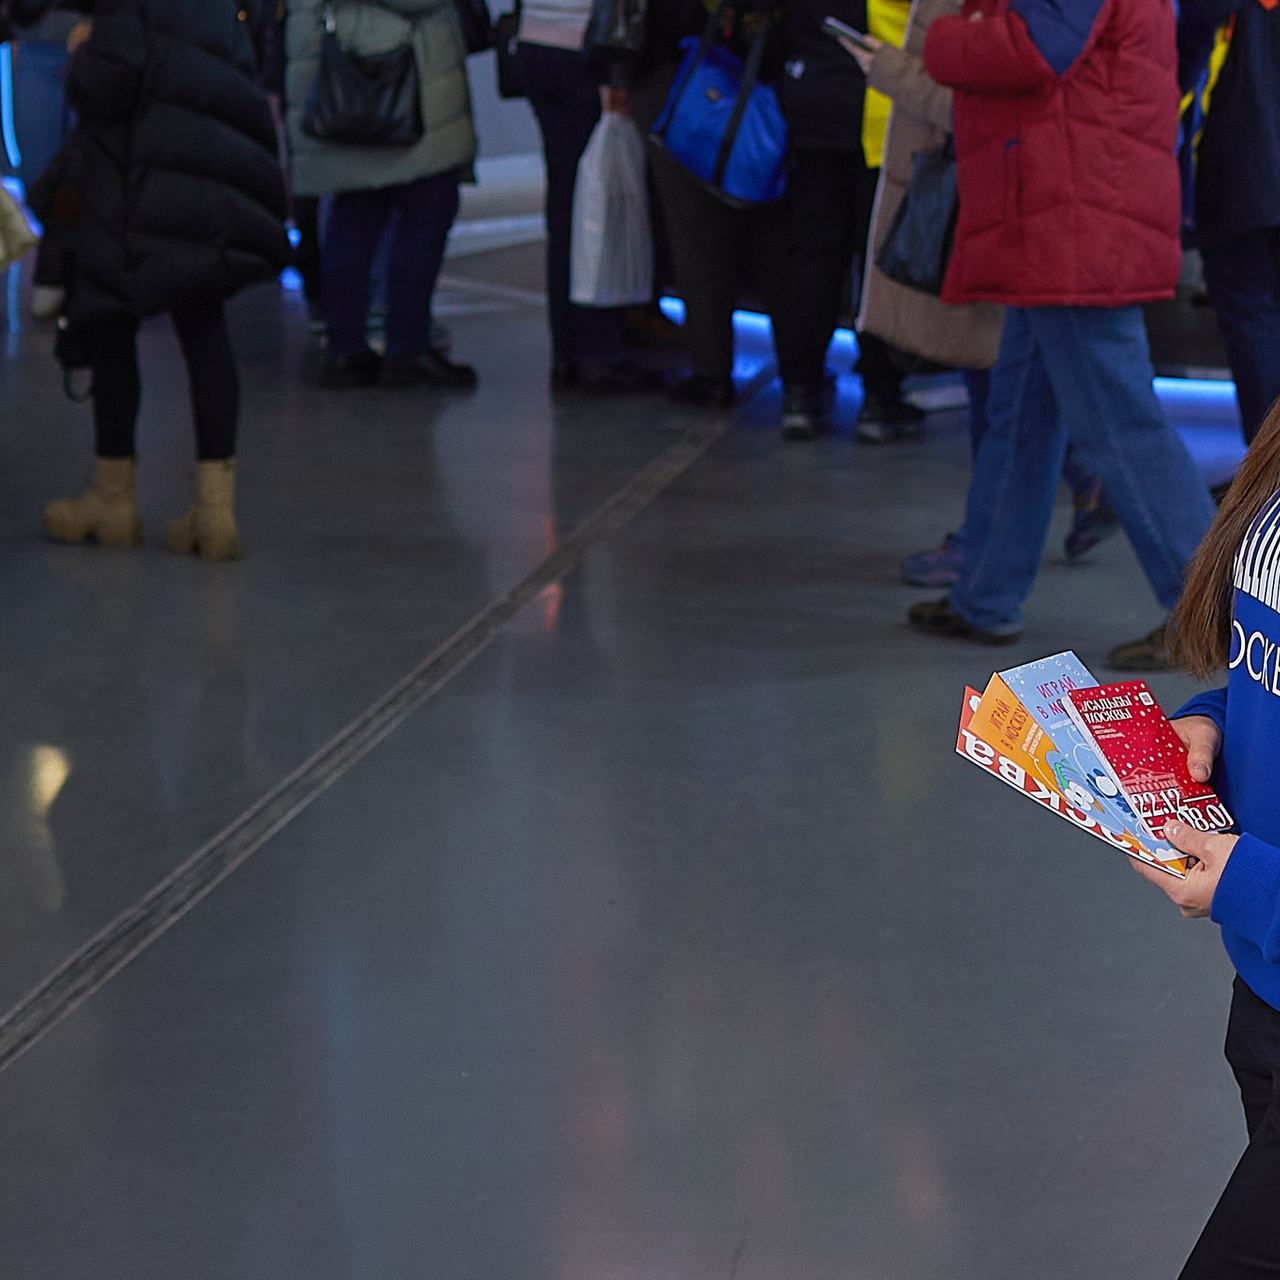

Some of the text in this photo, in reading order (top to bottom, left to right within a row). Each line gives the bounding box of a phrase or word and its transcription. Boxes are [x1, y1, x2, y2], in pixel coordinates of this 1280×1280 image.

[1036, 674, 1078, 699] ИГРАЙ
[989, 698, 1012, 730] ИГРАЙ
[1036, 706, 1049, 719] В
[1084, 708, 1133, 724] МОСКВЫ
[1000, 739, 1014, 751] В
[1131, 788, 1188, 818] 22.12
